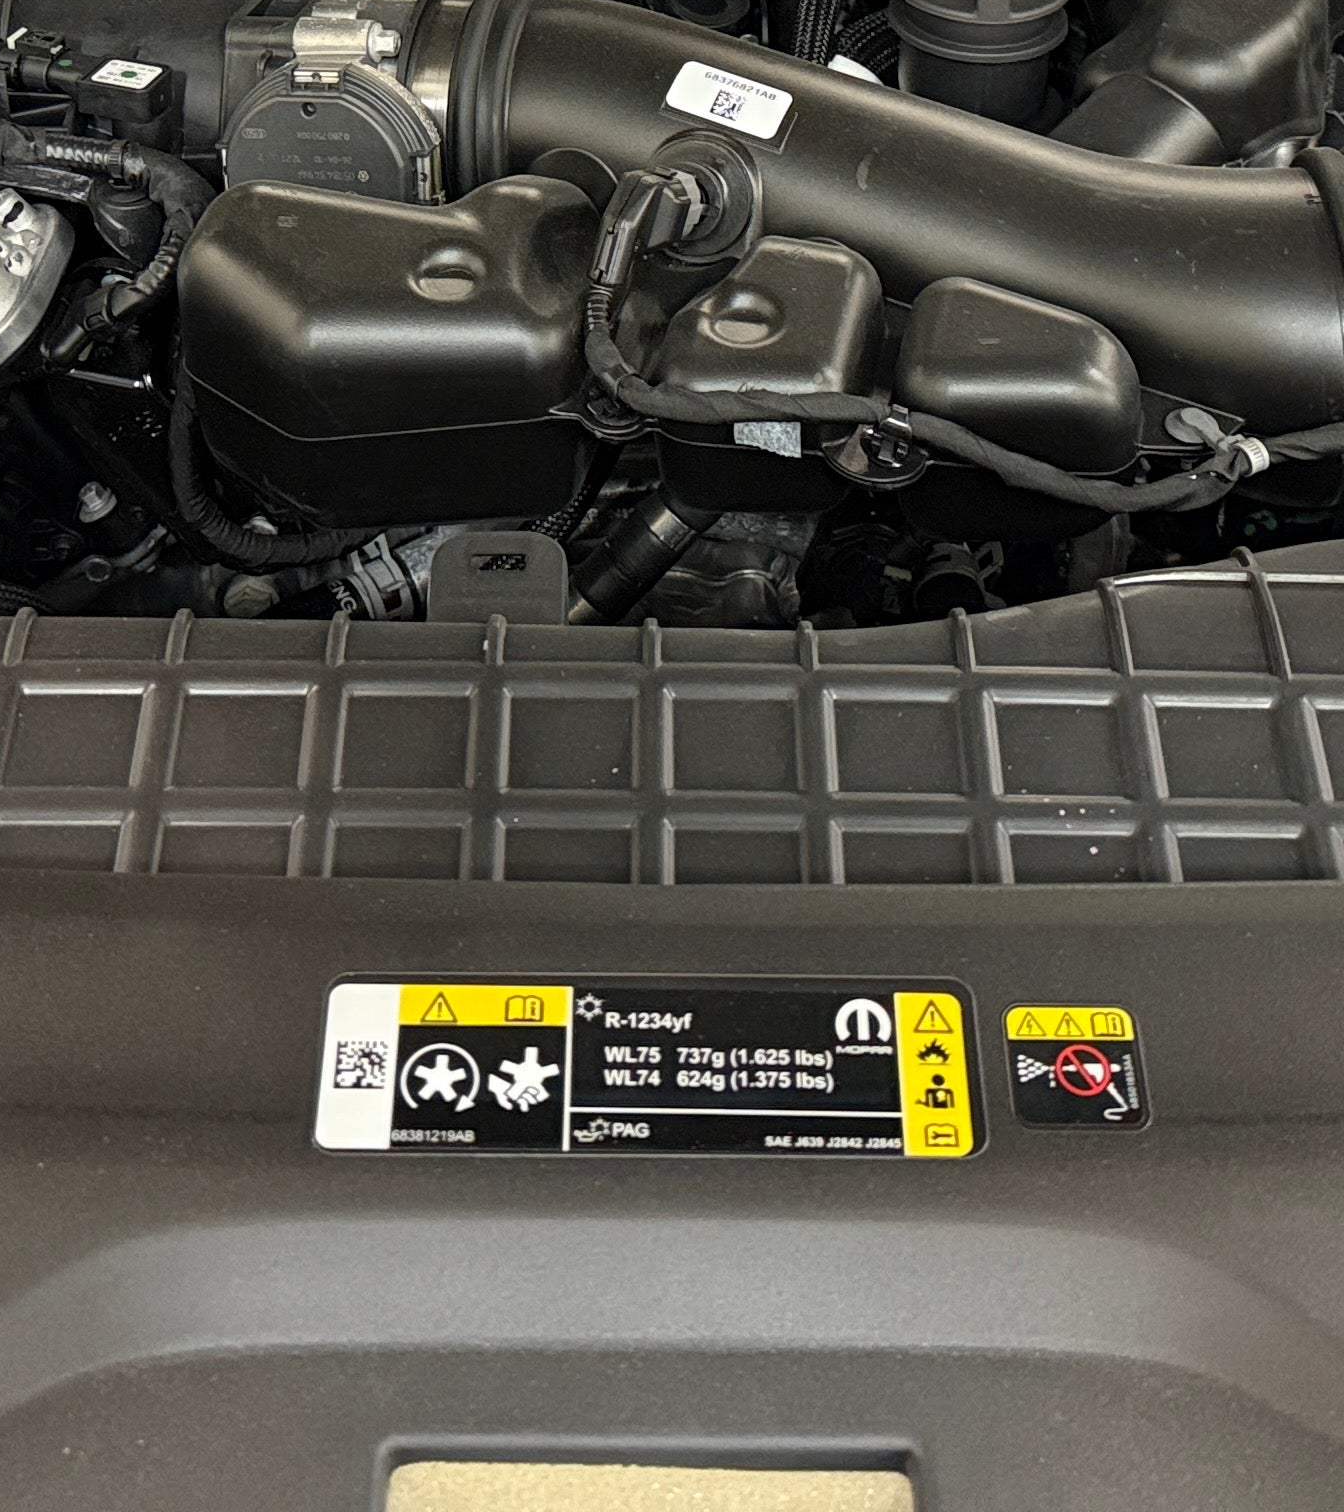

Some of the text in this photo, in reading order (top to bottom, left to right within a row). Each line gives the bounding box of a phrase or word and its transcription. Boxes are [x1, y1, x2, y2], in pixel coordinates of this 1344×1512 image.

[605, 1011, 693, 1034] R-1234yf
[603, 1045, 834, 1071] WL75 737g (1.625 lbs)
[835, 1044, 894, 1056] MOPAR
[603, 1068, 835, 1094] WL74 624g (1.375 lbs)
[390, 1129, 476, 1143] 68381219AB
[611, 1122, 651, 1139] PAG
[764, 1135, 793, 1147] SAE
[794, 1136, 825, 1148] J639
